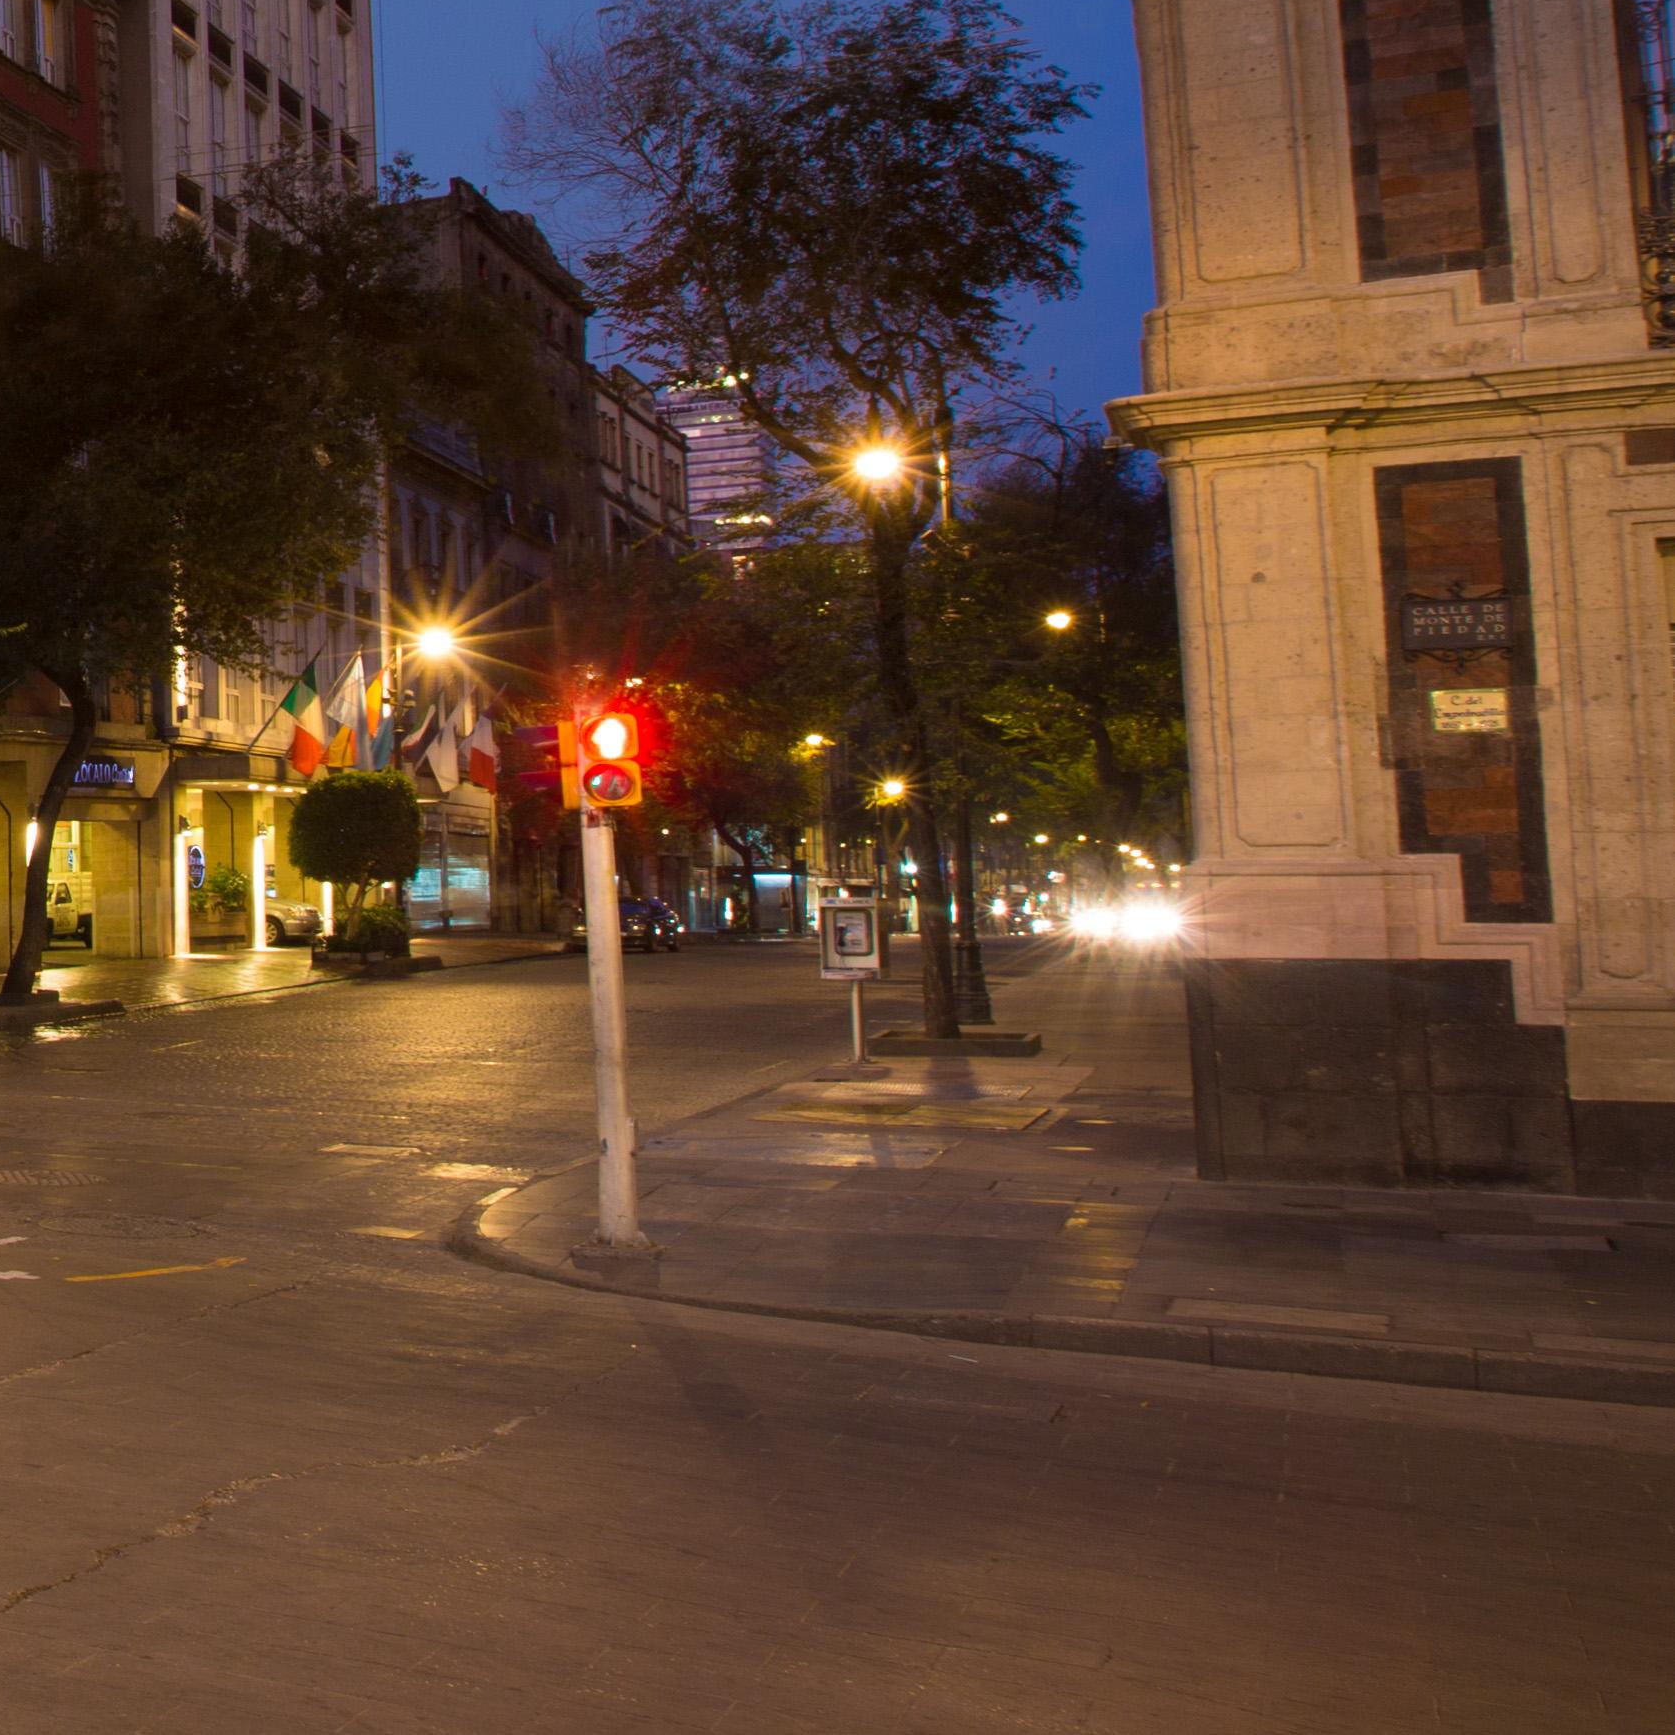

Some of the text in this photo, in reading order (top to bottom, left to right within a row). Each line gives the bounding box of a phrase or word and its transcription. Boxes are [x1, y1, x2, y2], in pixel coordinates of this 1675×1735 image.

[1412, 604, 1506, 616] CALLE DE
[1413, 614, 1506, 626] MONTE DE
